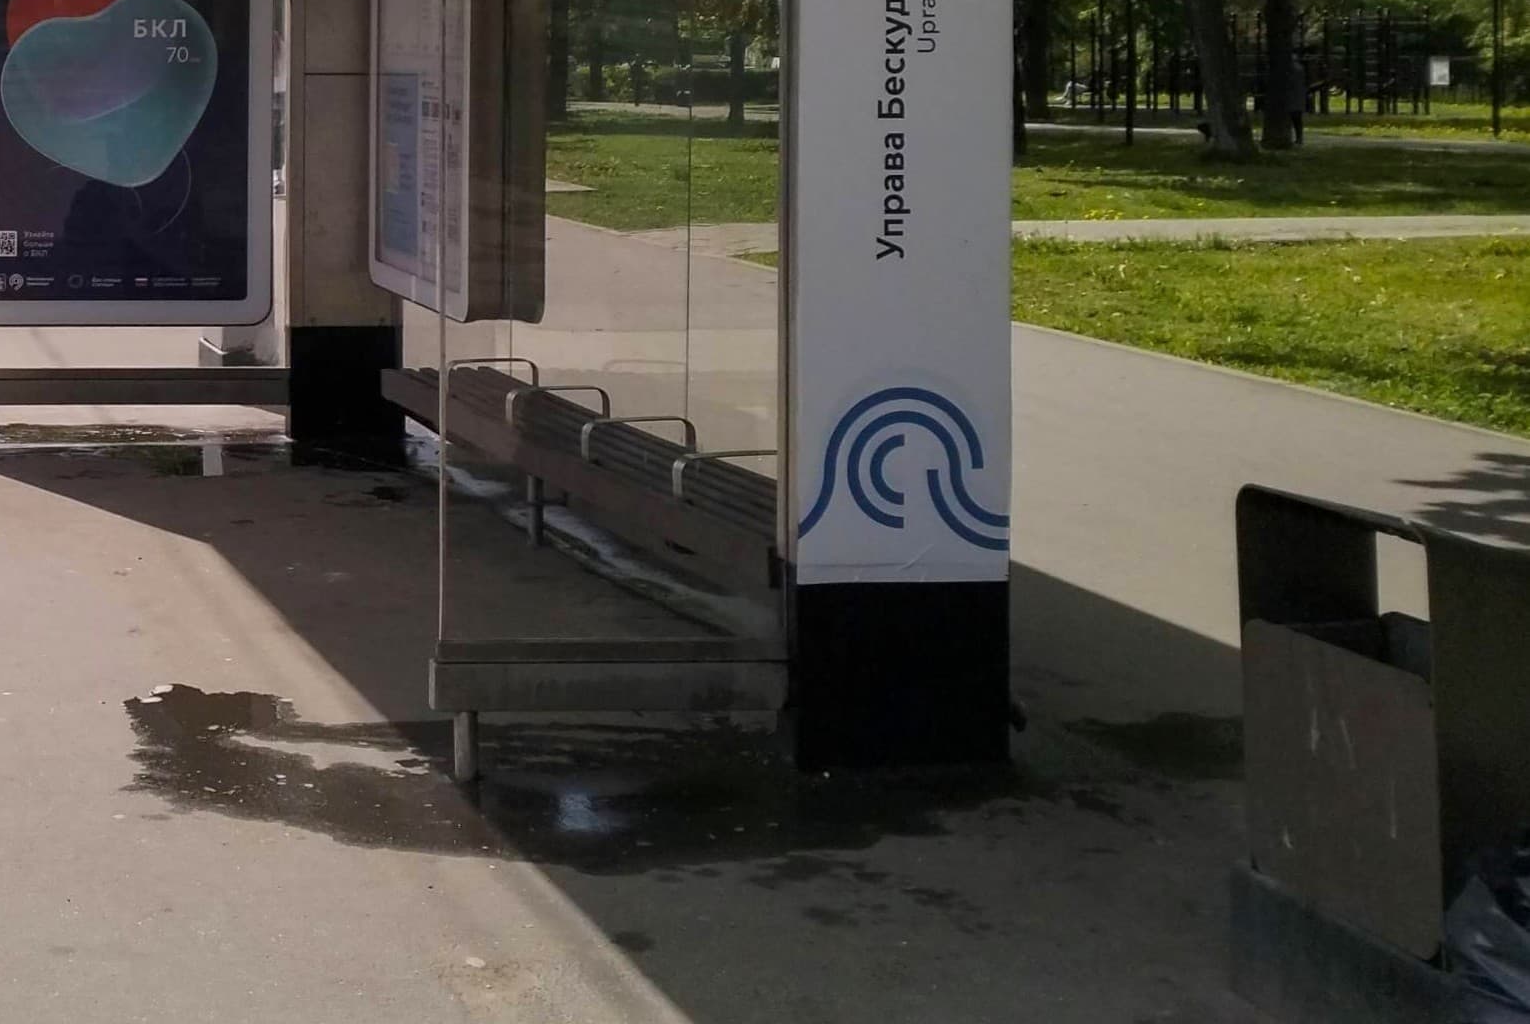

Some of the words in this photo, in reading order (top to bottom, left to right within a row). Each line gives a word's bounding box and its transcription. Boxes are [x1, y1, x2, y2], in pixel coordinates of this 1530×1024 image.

[133, 19, 187, 38] БКЛ
[166, 46, 189, 64] 70
[876, 133, 911, 260] Управа
